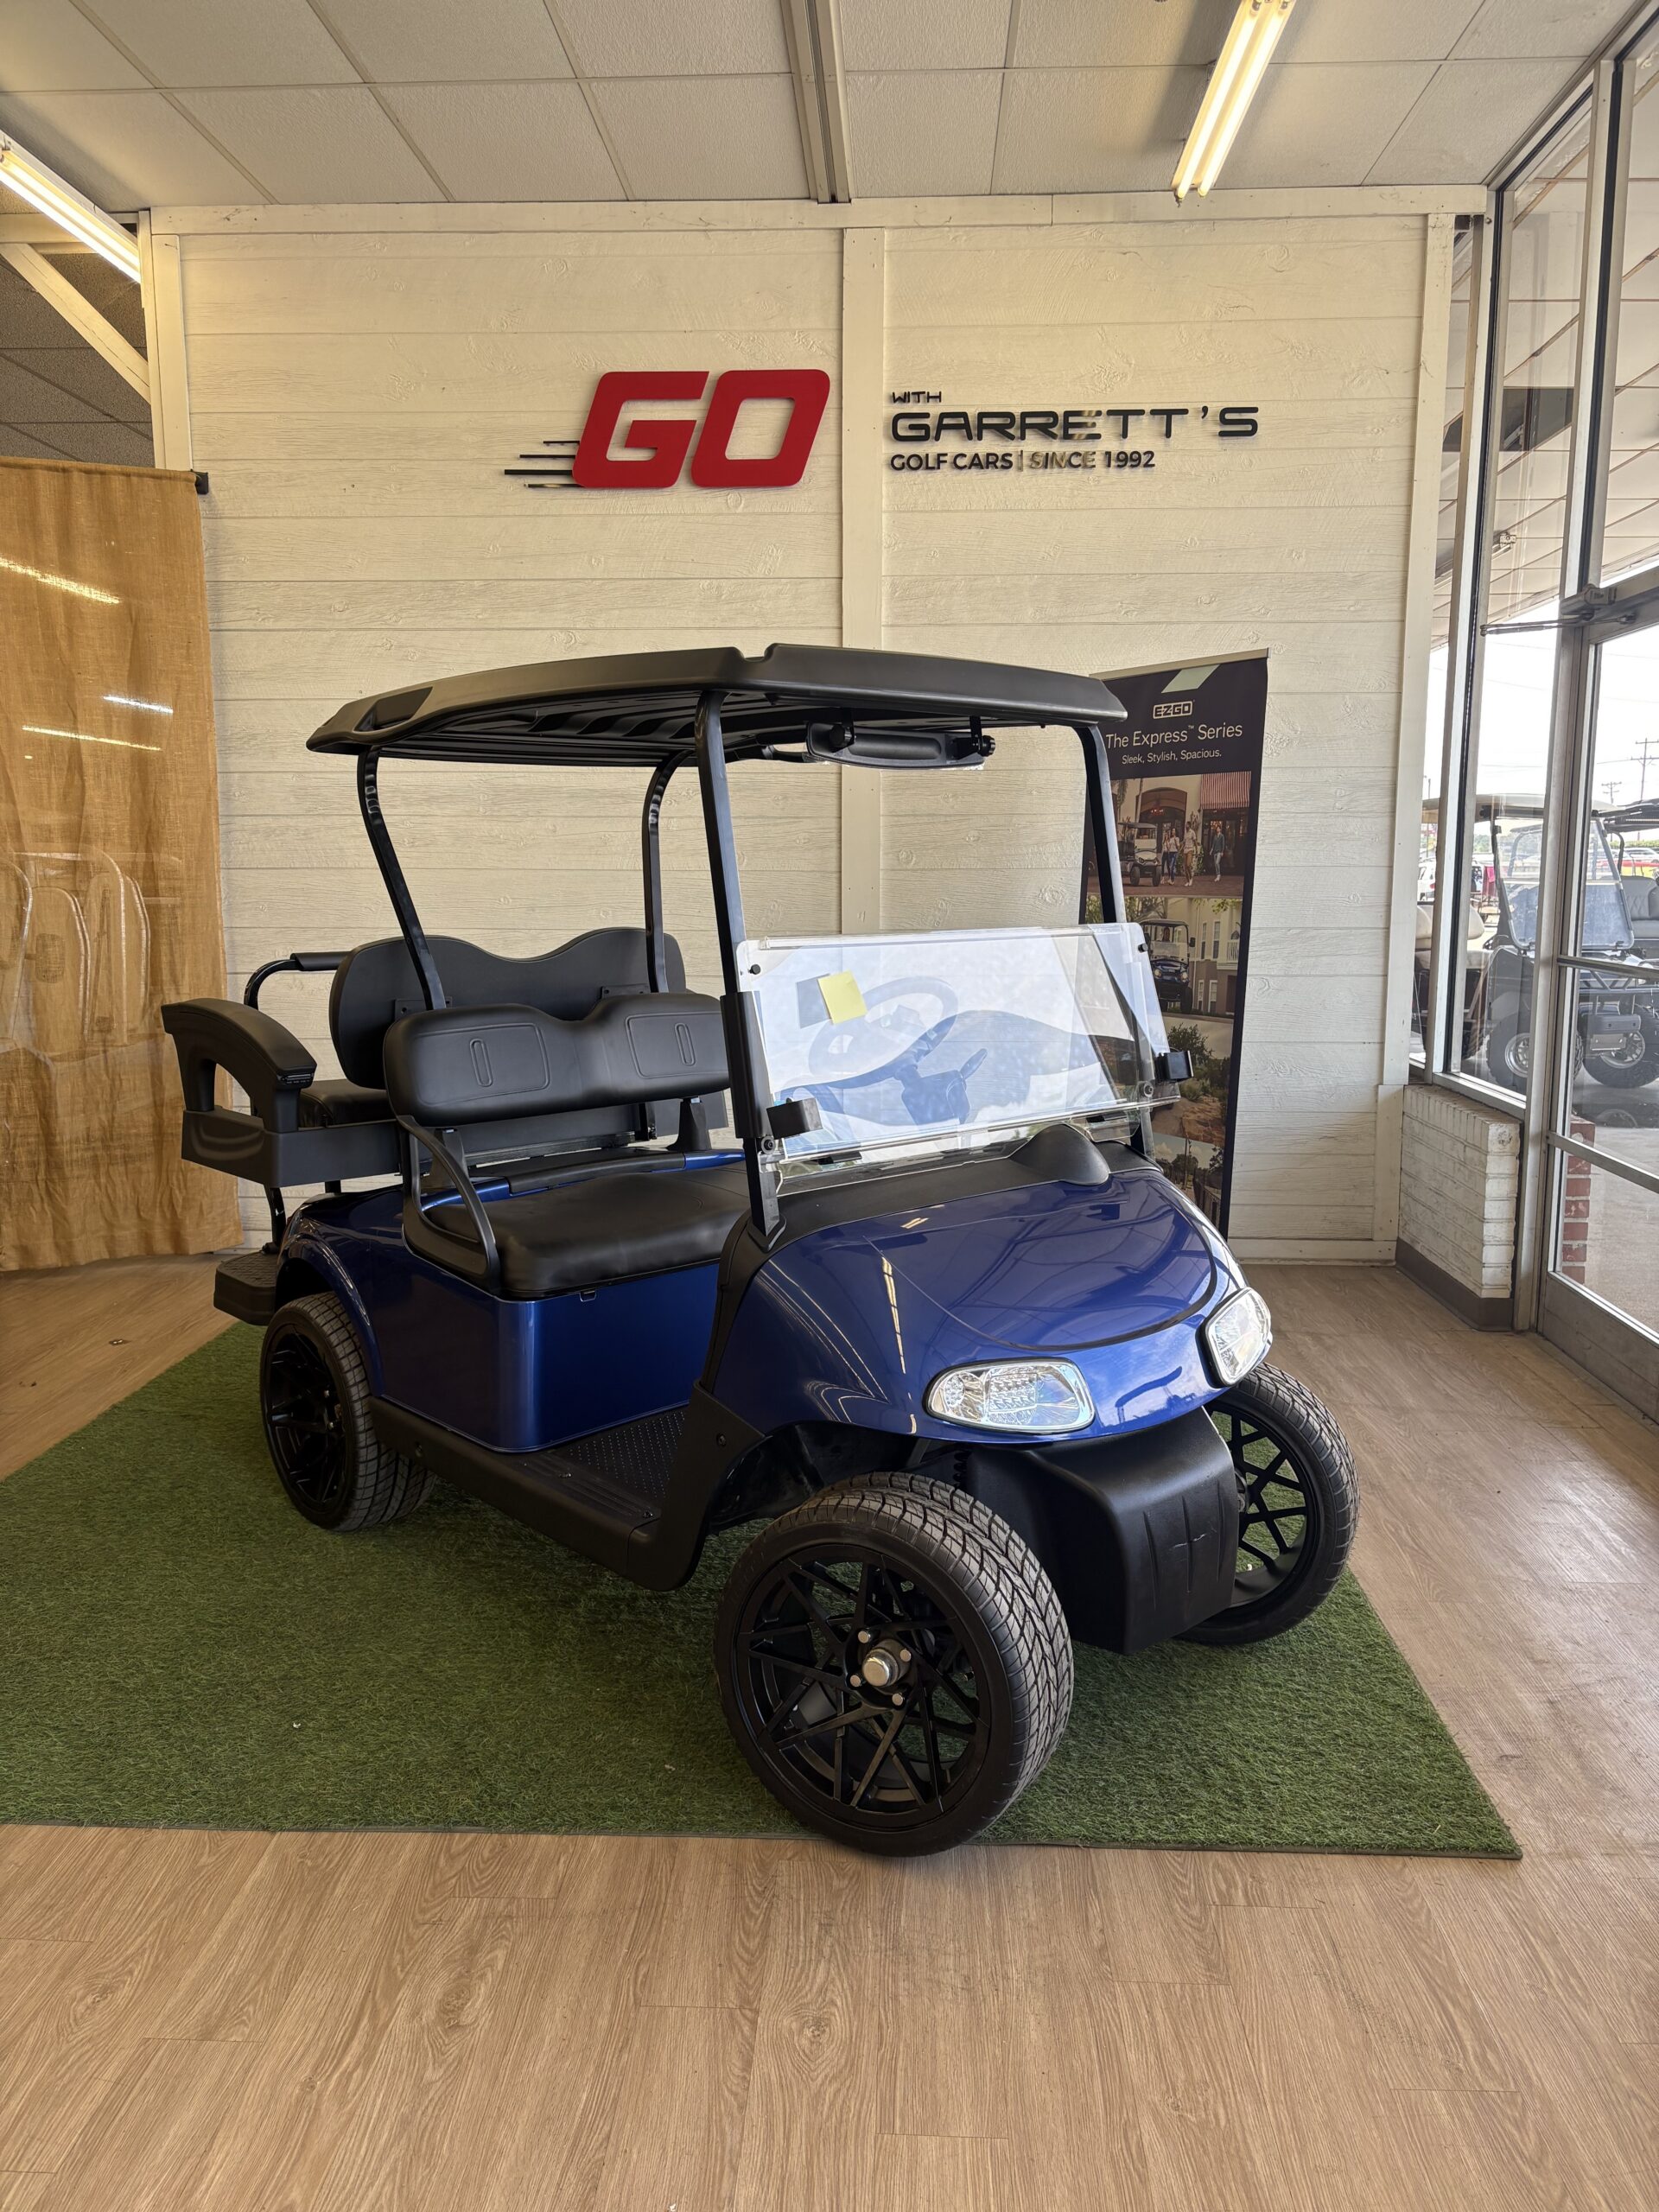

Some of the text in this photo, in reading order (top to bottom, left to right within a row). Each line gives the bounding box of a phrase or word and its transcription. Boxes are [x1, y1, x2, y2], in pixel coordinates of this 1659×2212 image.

[892, 391, 942, 404] WITH
[572, 369, 831, 488] GO
[891, 406, 1259, 442] GARRETT'S
[890, 451, 1156, 471] GOLF CARS SINCE 1992
[1105, 734, 1129, 749] The
[1198, 722, 1243, 741] Series
[1122, 748, 1222, 765] Sleek, Stylish, Spacious.
